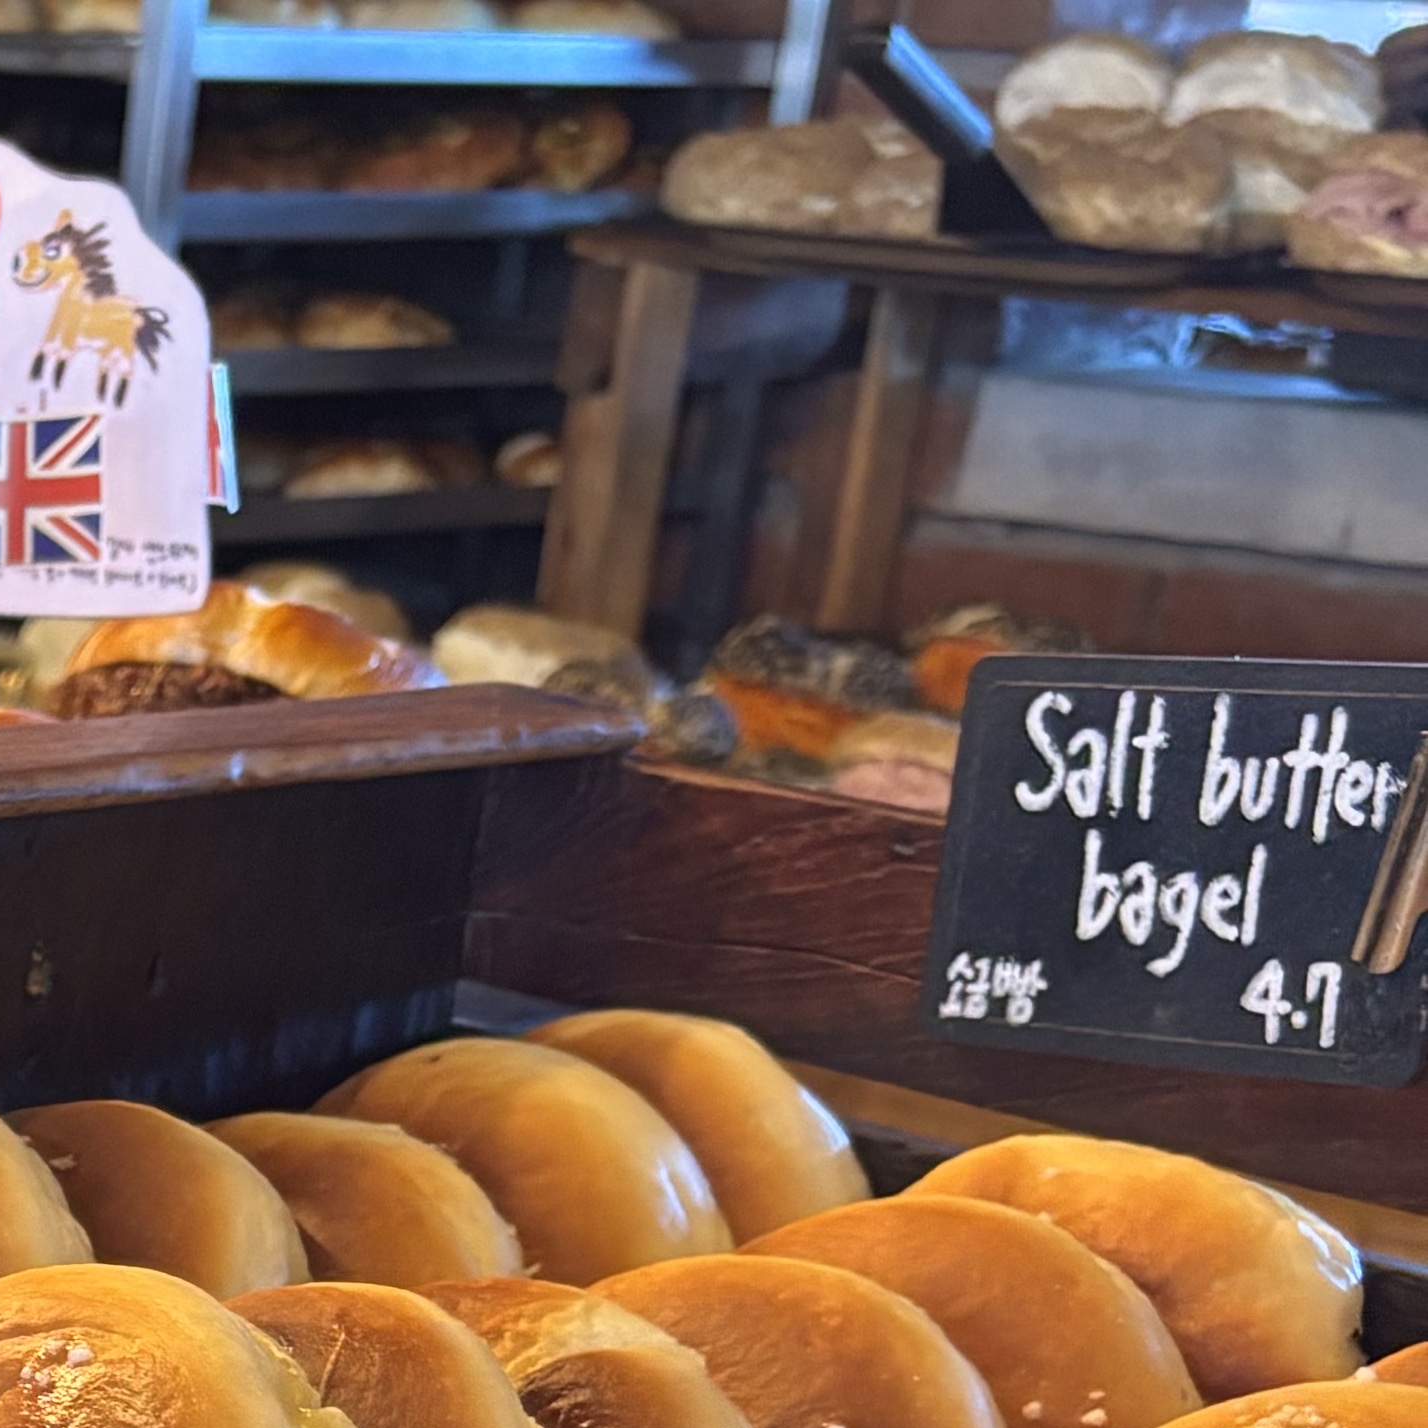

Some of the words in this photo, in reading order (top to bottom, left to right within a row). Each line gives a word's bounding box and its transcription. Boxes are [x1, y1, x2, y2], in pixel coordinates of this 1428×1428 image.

[1014, 690, 1171, 820] Salt
[1199, 692, 1407, 845] butter
[1075, 829, 1268, 978] bagel
[939, 951, 1048, 1026] 소금빵
[1240, 959, 1343, 1048] 4.7
